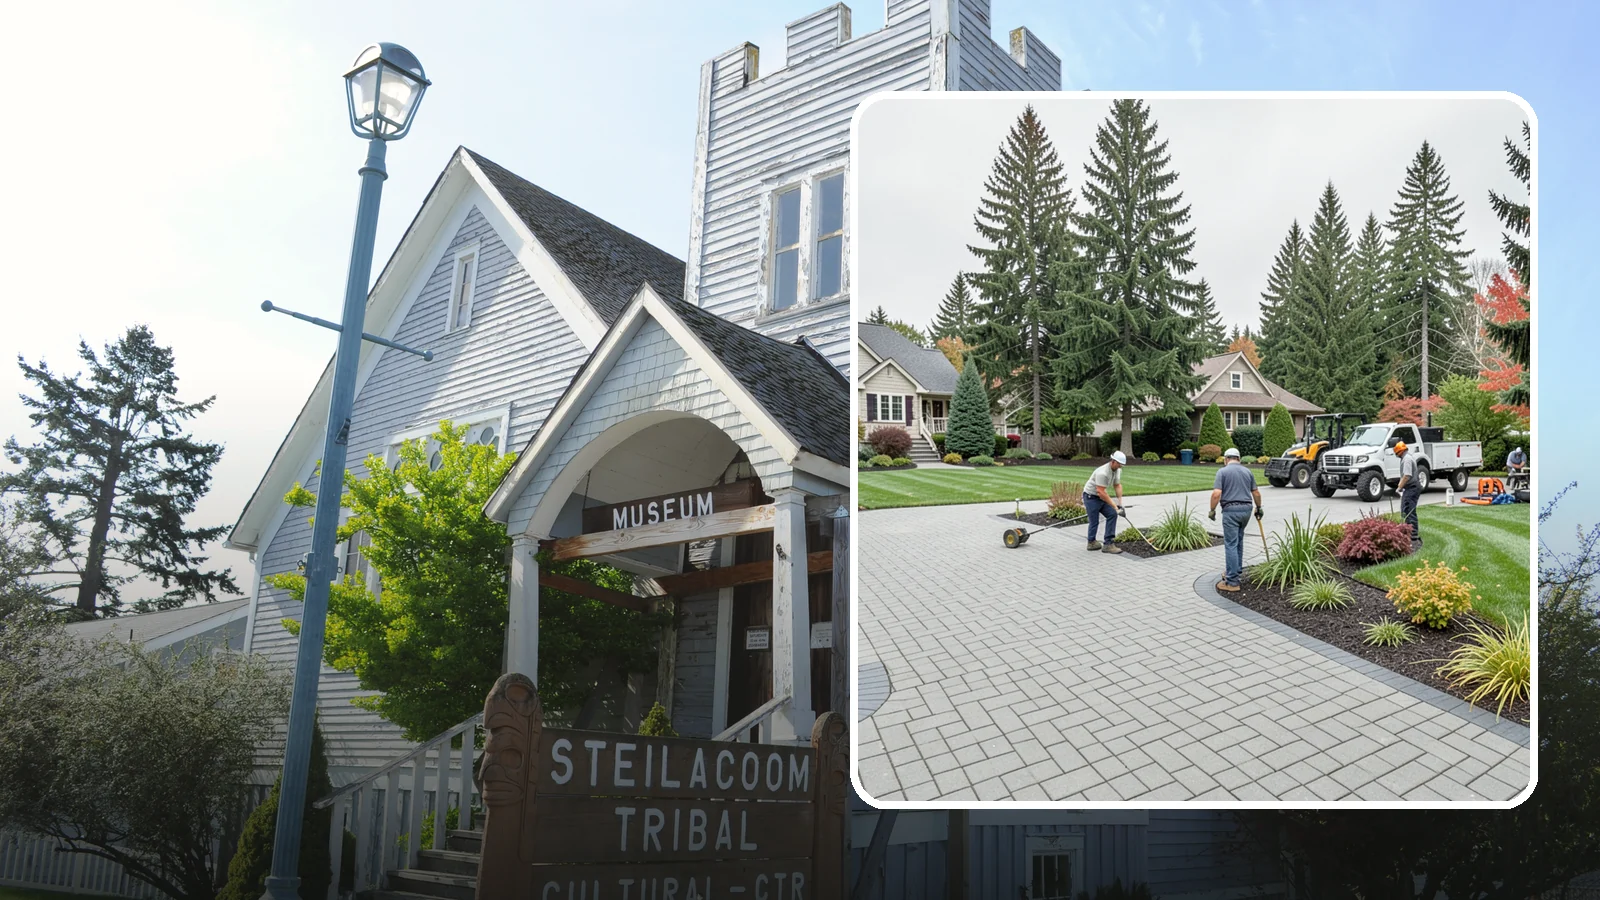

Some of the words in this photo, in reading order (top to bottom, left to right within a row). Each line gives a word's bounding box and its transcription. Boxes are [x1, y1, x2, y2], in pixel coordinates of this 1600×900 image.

[612, 491, 714, 531] MUSEUM
[550, 738, 810, 793] STEILACOOM
[615, 806, 758, 852] TRIBAL
